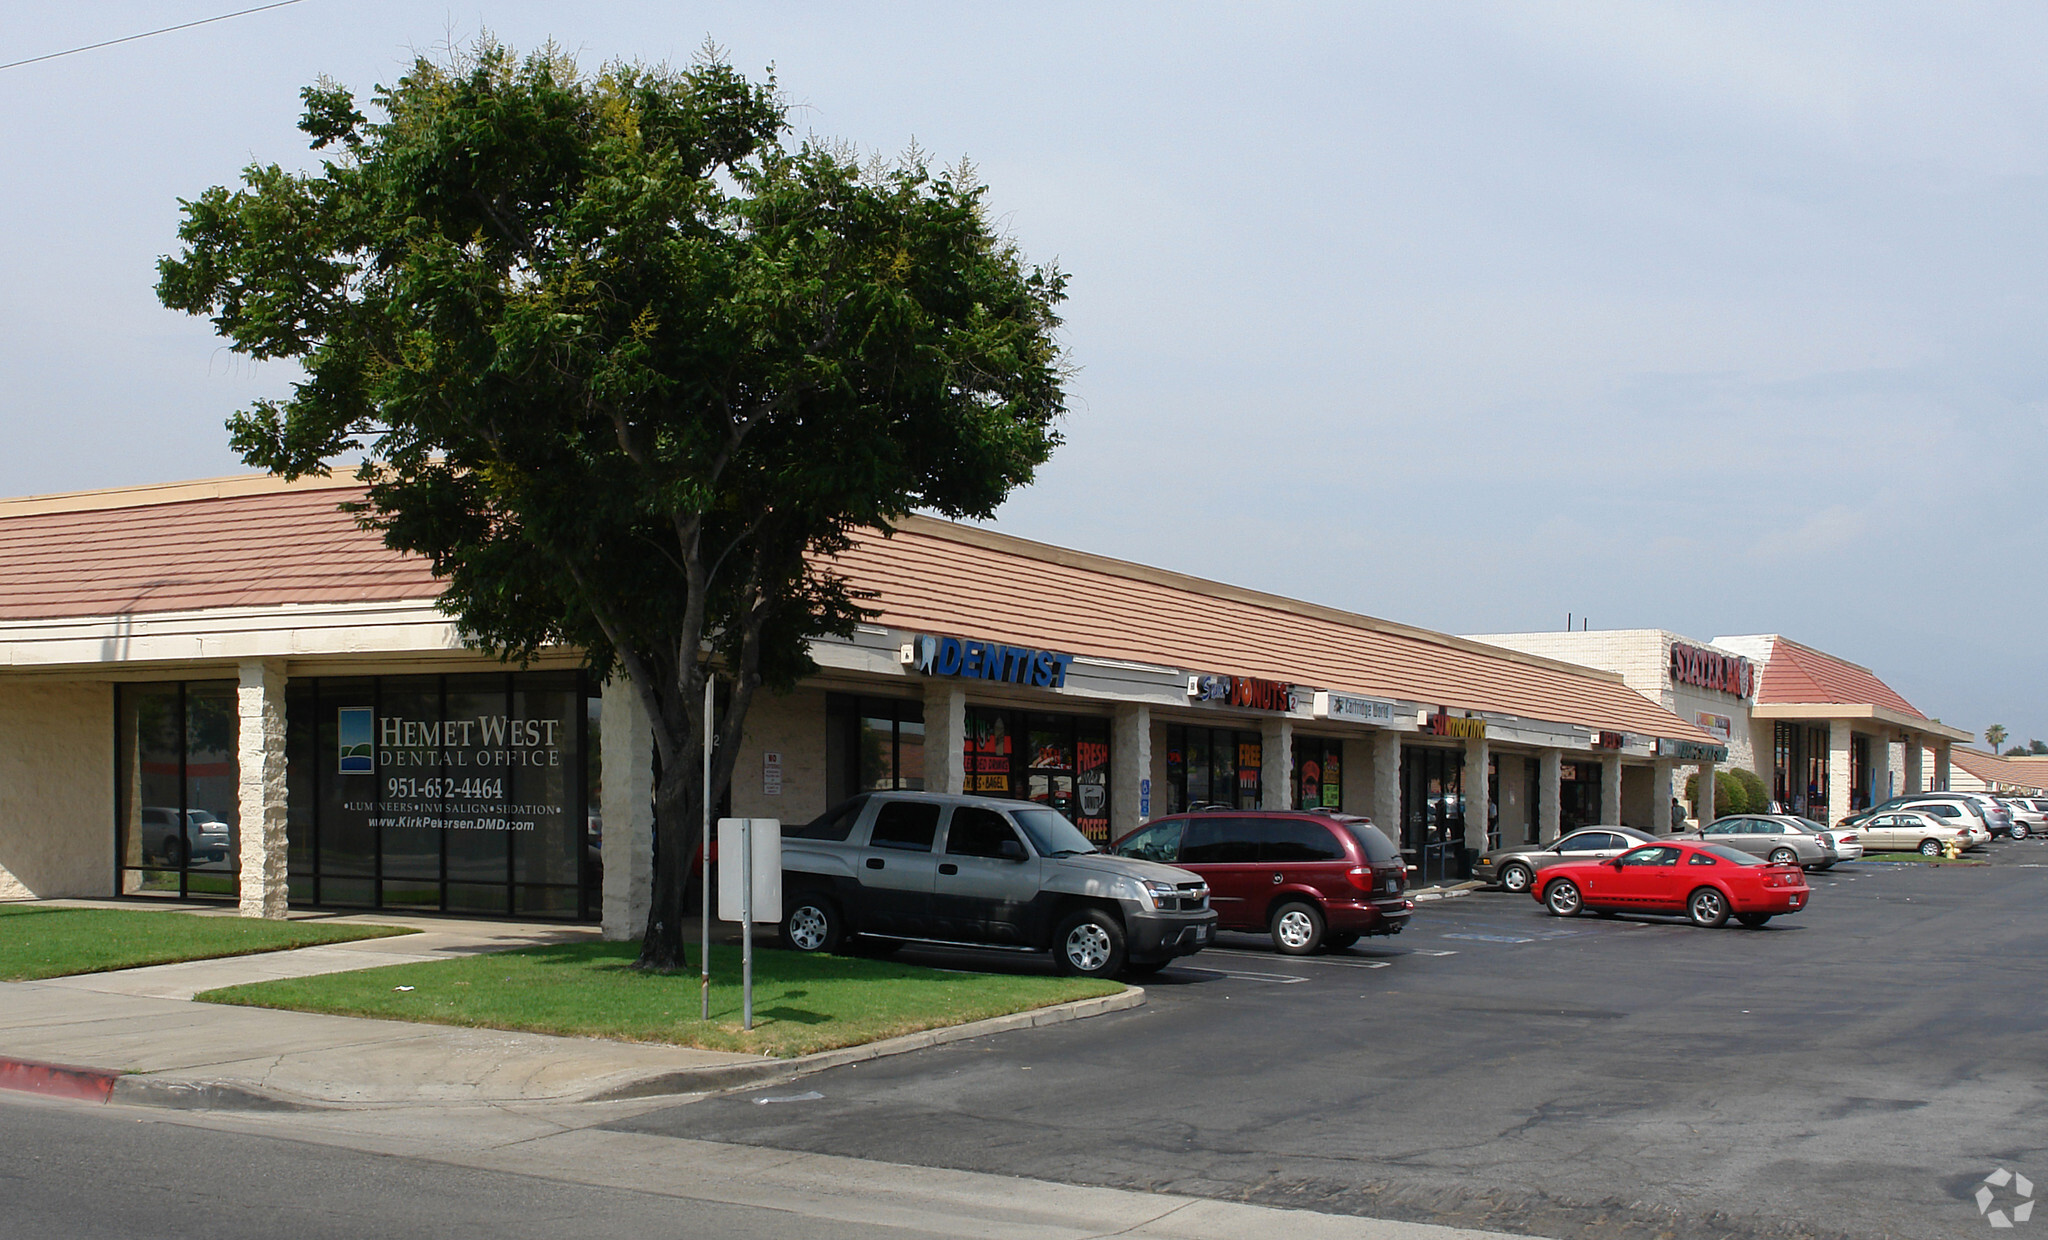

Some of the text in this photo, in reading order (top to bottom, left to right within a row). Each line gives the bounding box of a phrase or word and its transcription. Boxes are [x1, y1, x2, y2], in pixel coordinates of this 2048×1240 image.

[937, 637, 1073, 687] DENTIST
[1676, 641, 1724, 692] STATER
[1231, 677, 1287, 711] DONUTS
[1290, 697, 1297, 710] 2
[1373, 703, 1389, 719] World
[379, 715, 559, 747] HEMET WEST
[379, 750, 559, 767] DENTAL OFFICE
[1077, 742, 1108, 775] FRESH
[1239, 743, 1261, 768] FREE
[388, 777, 503, 799] 951-652-4464
